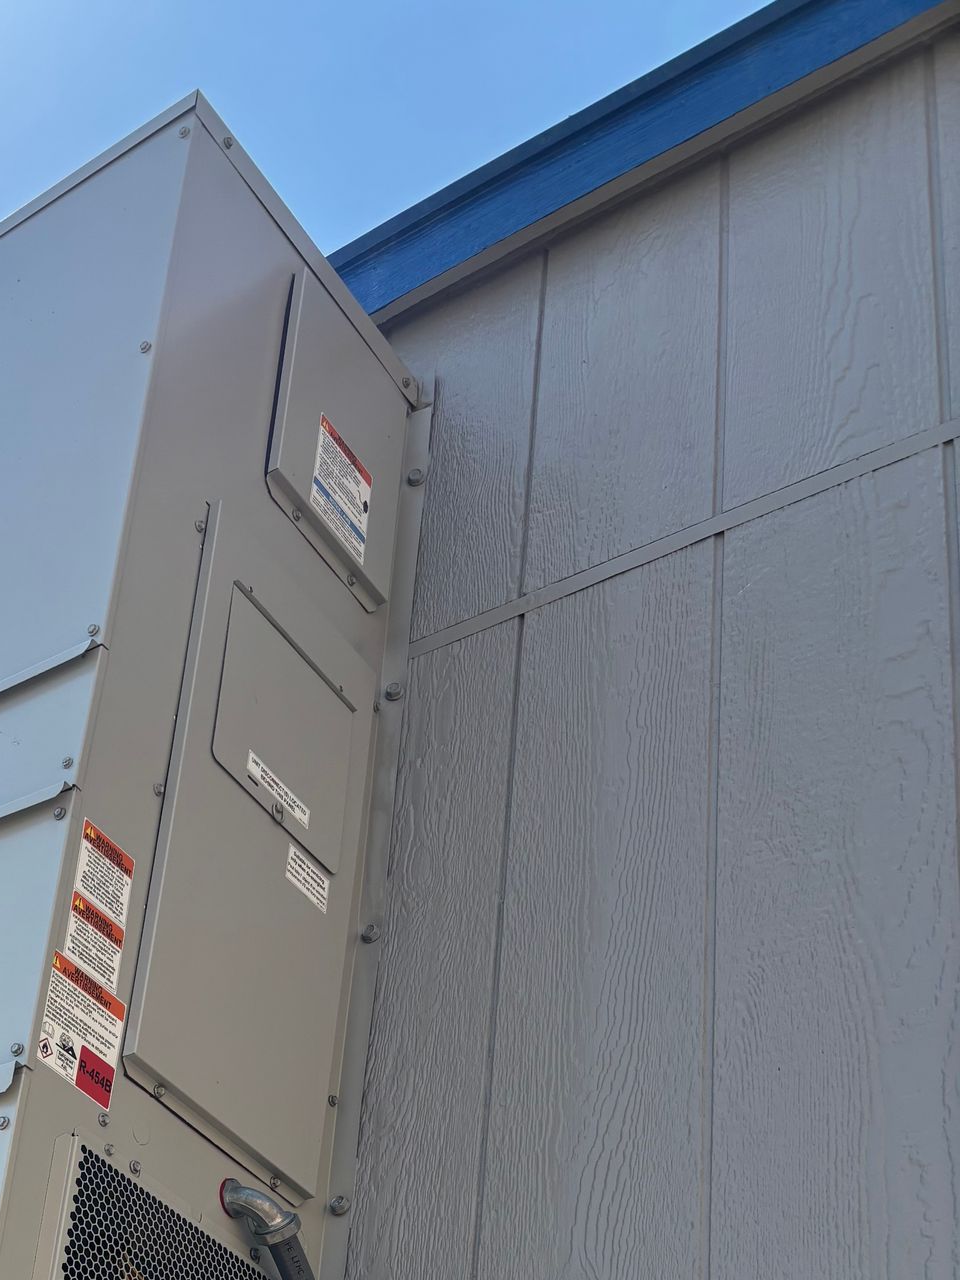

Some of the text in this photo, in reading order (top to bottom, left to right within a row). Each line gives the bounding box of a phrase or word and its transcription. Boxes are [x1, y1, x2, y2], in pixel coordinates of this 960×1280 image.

[85, 833, 131, 878] AVERTISSEMENT
[96, 833, 123, 863] WARNING
[74, 904, 121, 949] AVERTISSEMENT
[85, 904, 112, 932] WARNING
[63, 967, 111, 1010] AVERTISSEMENT
[75, 966, 102, 995] WARNING
[80, 1060, 112, 1093] R-454B
